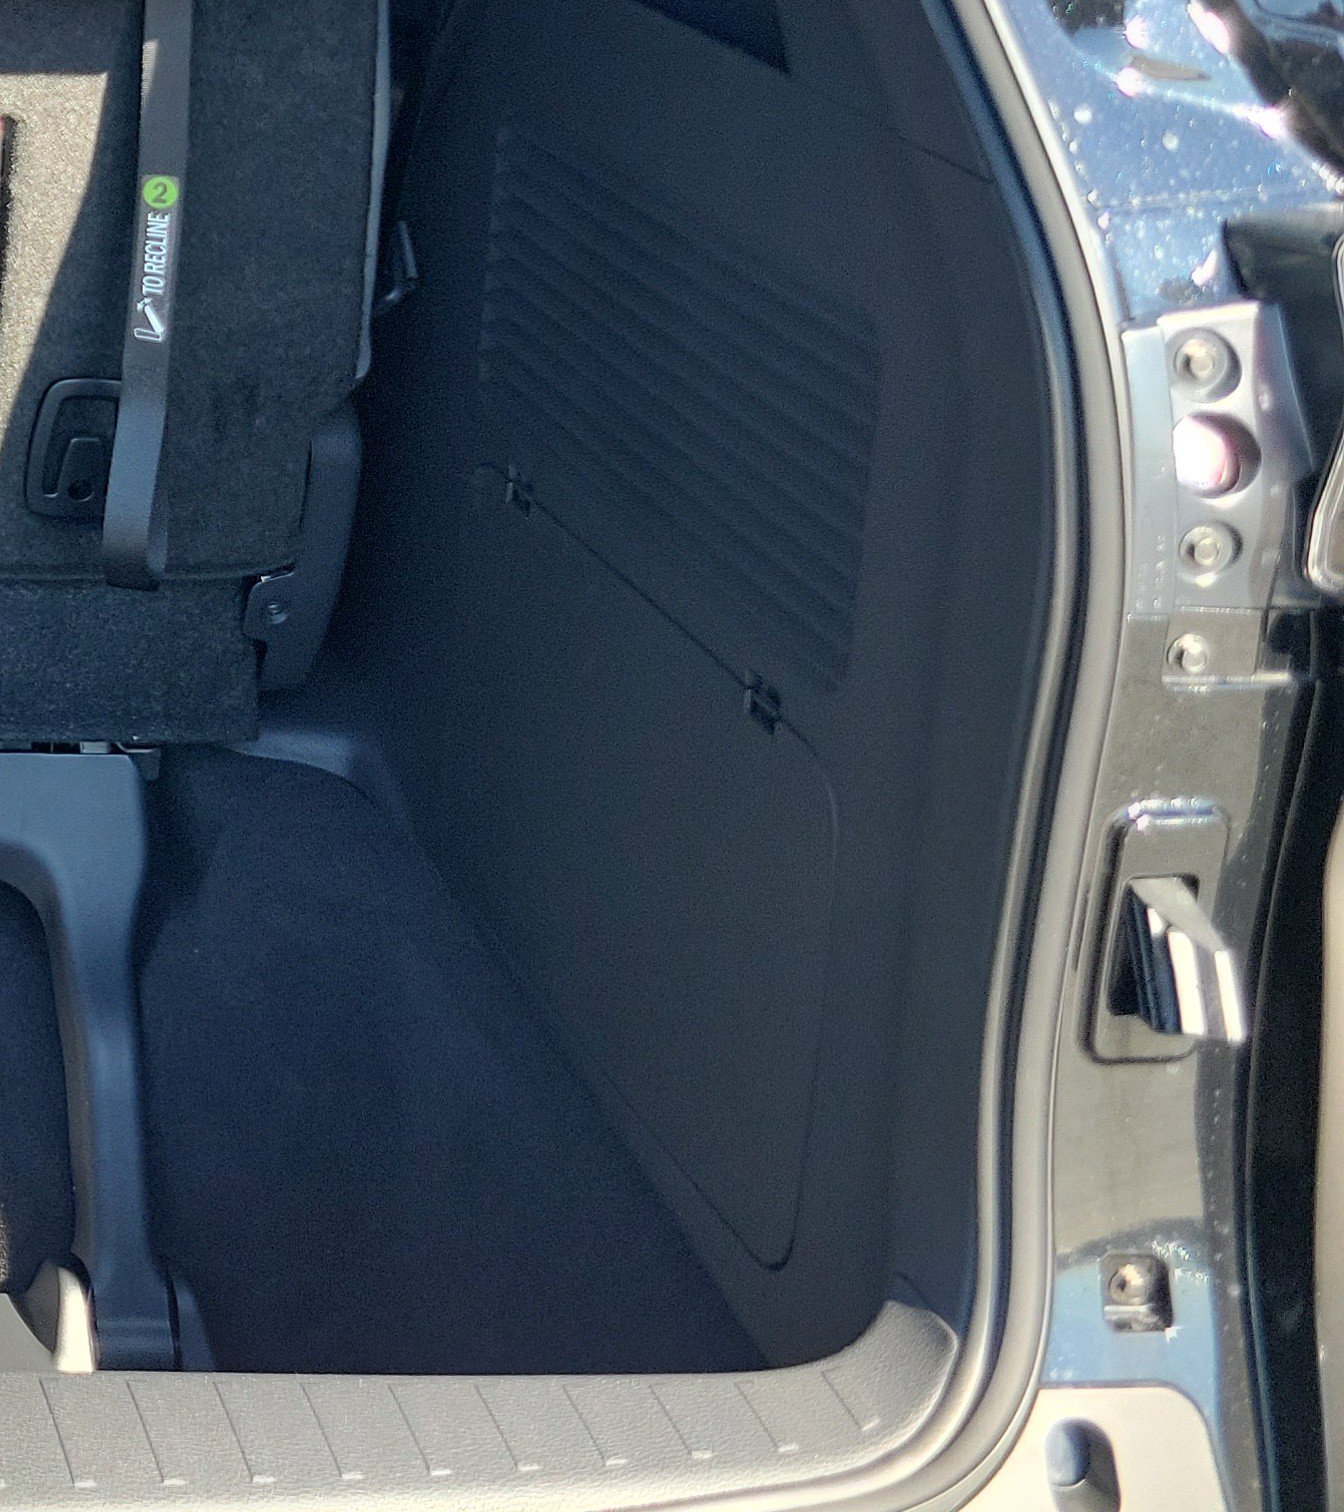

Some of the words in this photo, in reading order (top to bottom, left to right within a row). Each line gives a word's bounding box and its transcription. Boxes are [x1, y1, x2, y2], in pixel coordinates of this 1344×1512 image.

[153, 181, 168, 203] 2
[144, 212, 169, 273] RECLINE
[142, 276, 164, 296] TO
